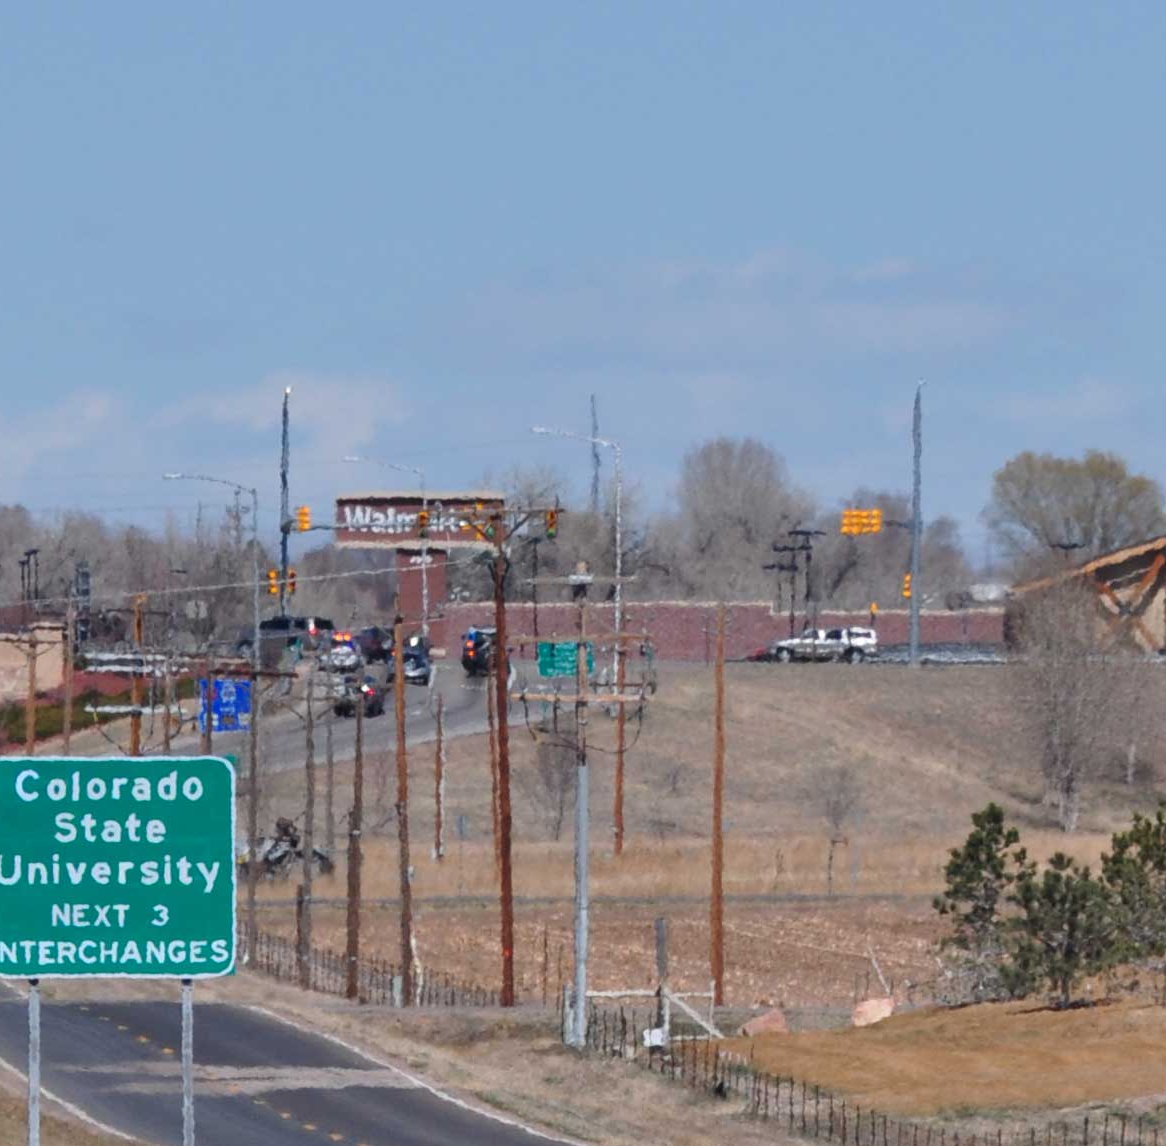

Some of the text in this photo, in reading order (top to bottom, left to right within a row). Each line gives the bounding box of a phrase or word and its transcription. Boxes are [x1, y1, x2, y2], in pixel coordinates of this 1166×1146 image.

[15, 769, 204, 801] Colorado
[54, 812, 166, 843] State
[51, 903, 170, 927] NEXT 3
